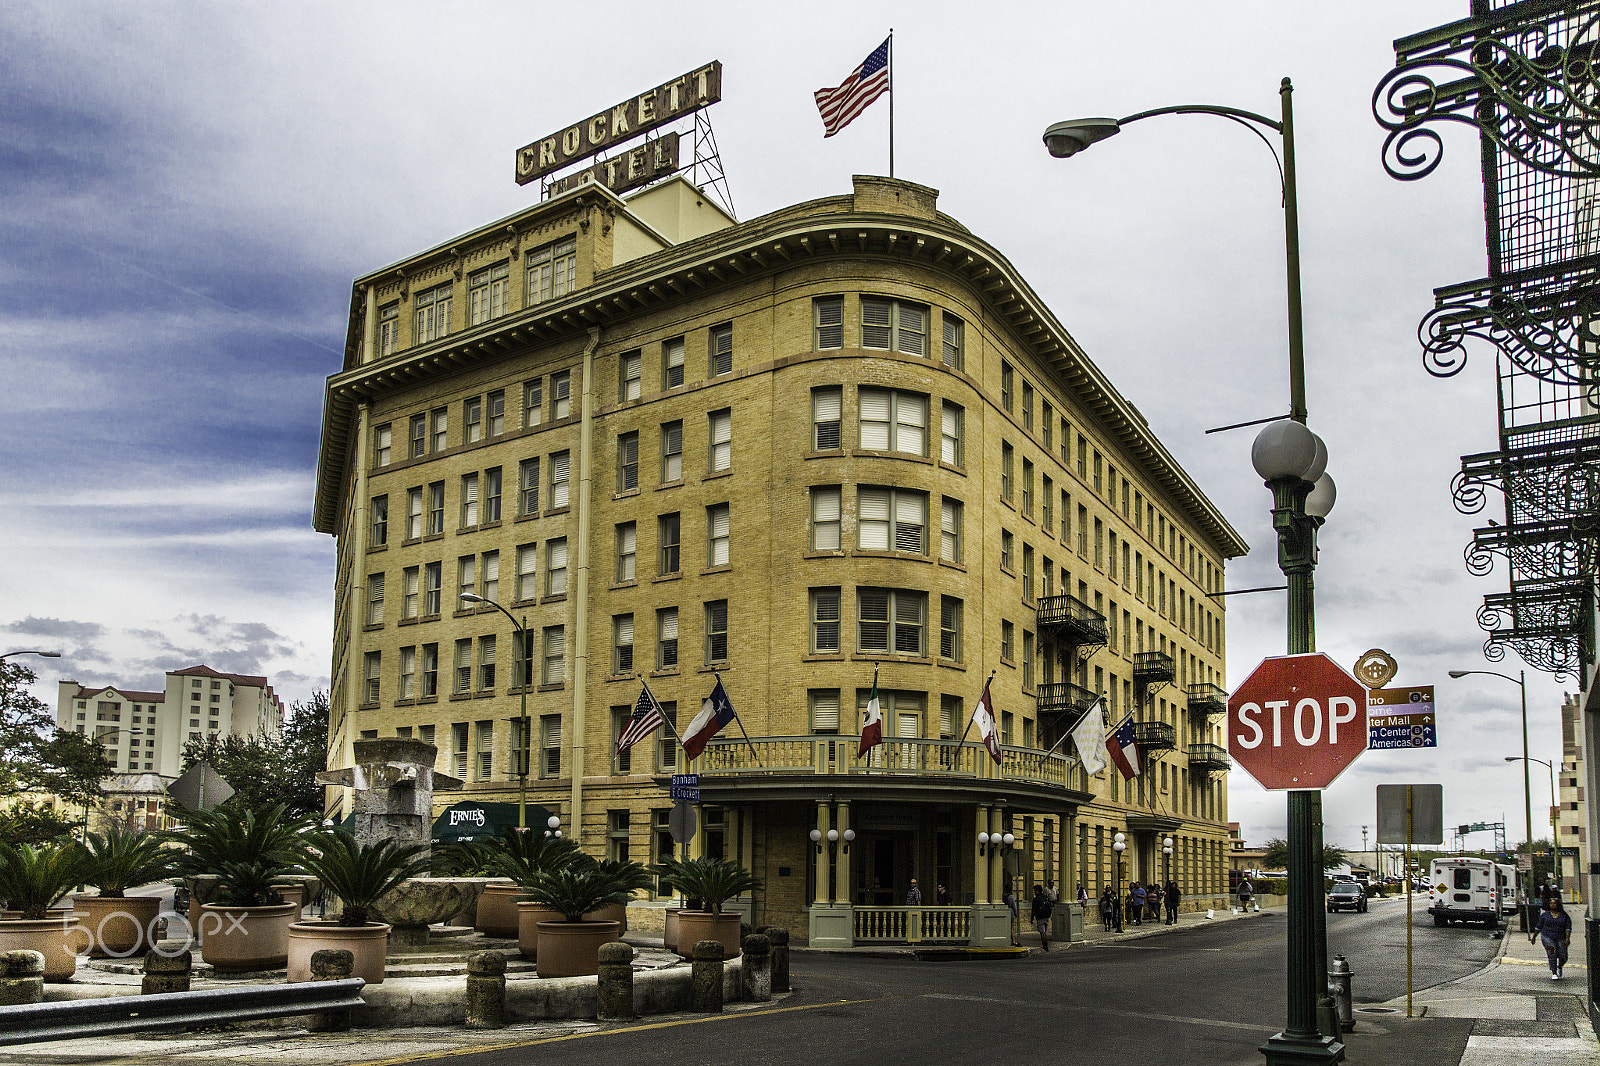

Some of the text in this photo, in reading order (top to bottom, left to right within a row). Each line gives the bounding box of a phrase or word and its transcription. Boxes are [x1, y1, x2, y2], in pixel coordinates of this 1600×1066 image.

[517, 62, 714, 177] CROCKETT
[1236, 696, 1357, 750] STOP
[1369, 715, 1410, 727] ter Mall
[1380, 727, 1411, 738] Center
[1371, 738, 1413, 748] Americas
[672, 775, 697, 785] Bonham
[449, 808, 485, 827] ERNIE'S
